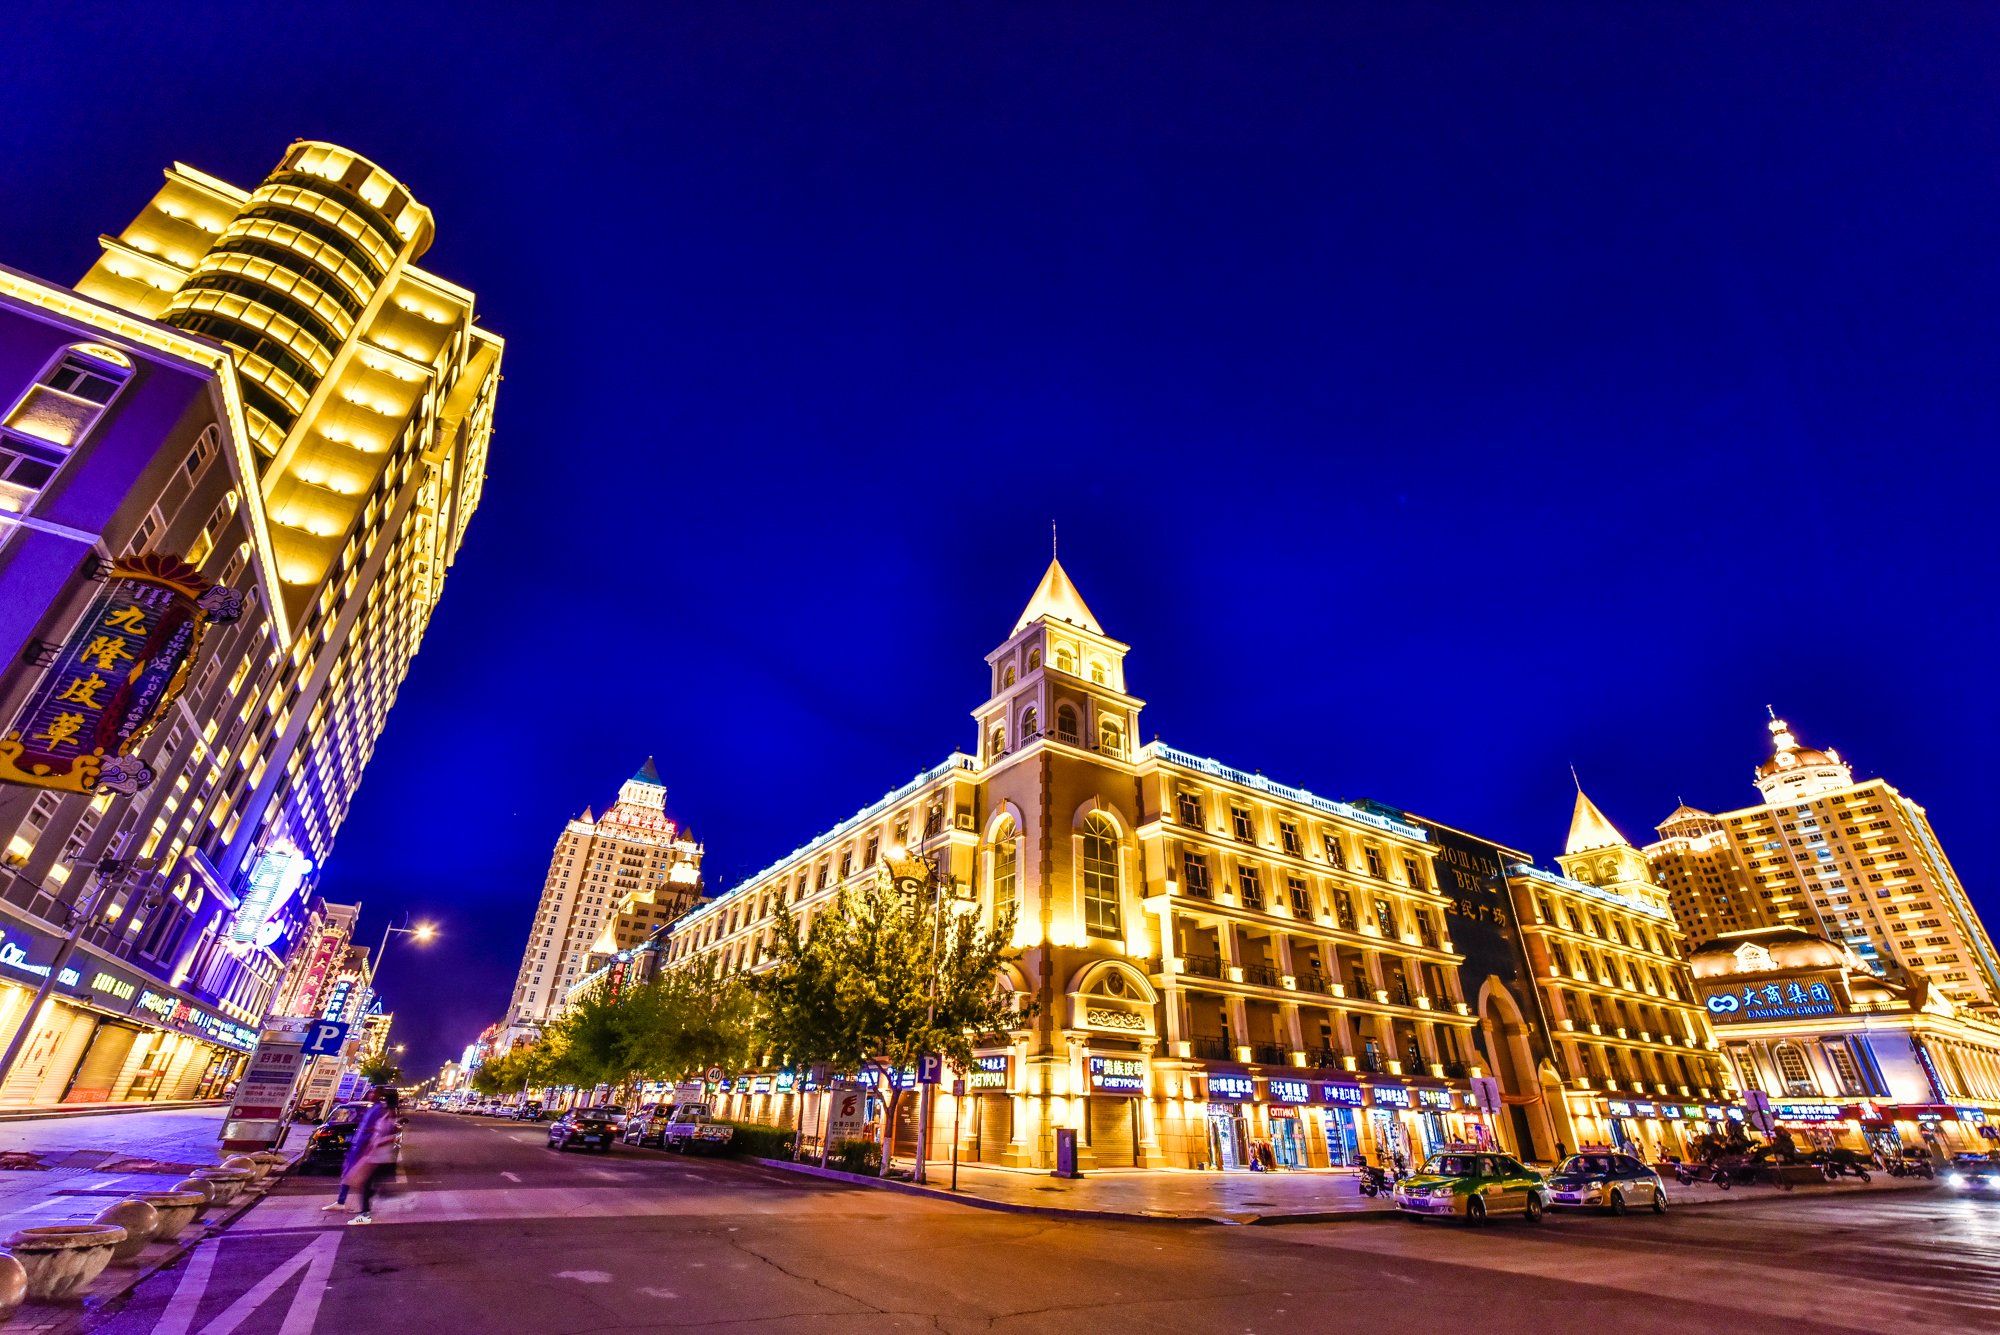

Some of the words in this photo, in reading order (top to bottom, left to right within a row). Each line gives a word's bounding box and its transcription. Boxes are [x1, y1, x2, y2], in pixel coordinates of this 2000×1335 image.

[32, 605, 147, 752] 九隆皮草
[1439, 844, 1498, 877] ЛОЩАДЬ
[1743, 982, 1830, 1006] 大商集团
[1747, 1007, 1795, 1018] DASHANG
[1796, 1004, 1834, 1016] GROUP
[311, 1025, 340, 1050] P
[708, 1070, 721, 1080] 40
[922, 1056, 938, 1080] P
[1104, 1077, 1144, 1089] СНЕГУРОЧКА
[1270, 1107, 1295, 1117] ОПТИКА
